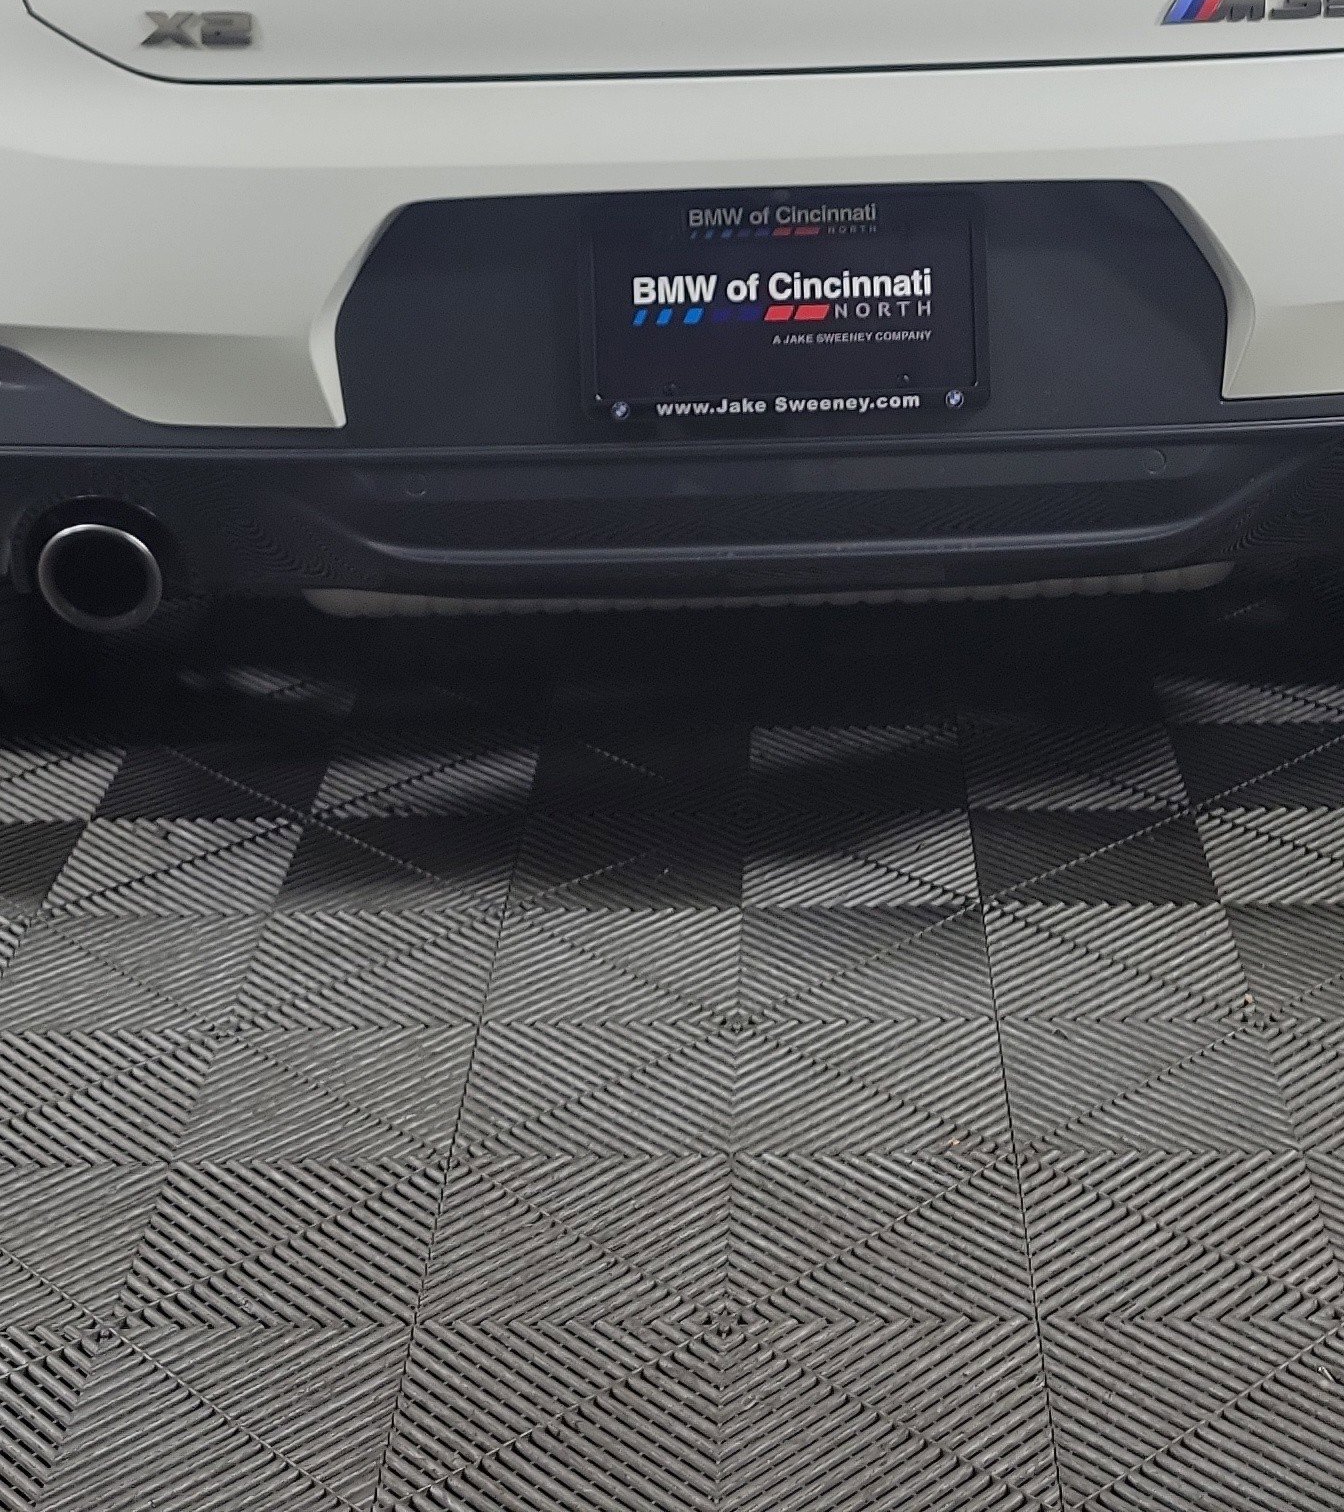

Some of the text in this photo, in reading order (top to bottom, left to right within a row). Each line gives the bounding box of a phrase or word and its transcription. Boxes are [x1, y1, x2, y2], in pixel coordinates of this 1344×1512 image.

[688, 203, 876, 227] BMW of Cincinnati
[633, 268, 933, 305] BMW of Cincinnati
[833, 300, 933, 319] NORTH
[772, 329, 932, 345] A JAKE SWEENEY COMPANY
[656, 395, 920, 416] www.Jake Sweeney.com
